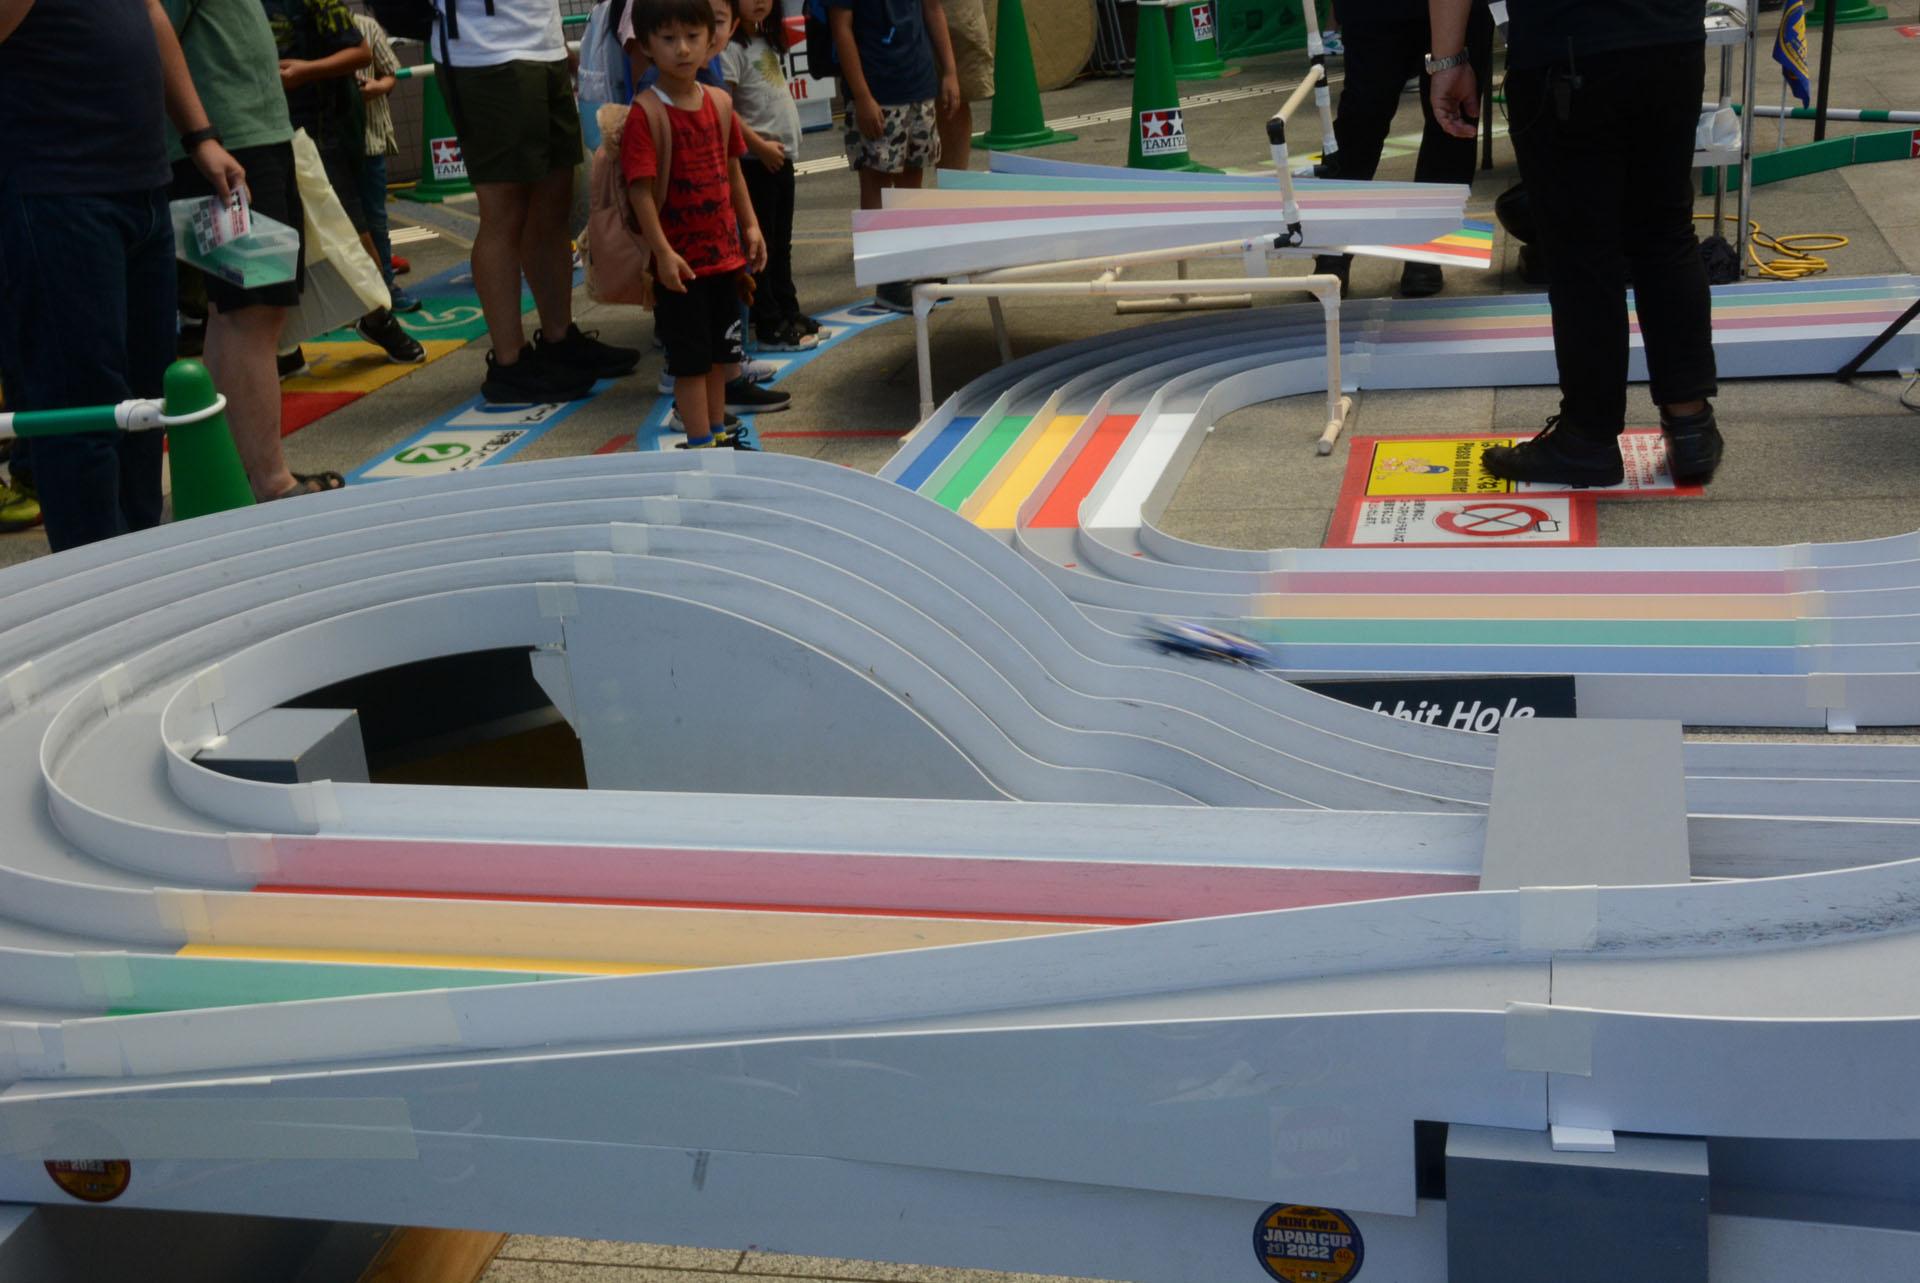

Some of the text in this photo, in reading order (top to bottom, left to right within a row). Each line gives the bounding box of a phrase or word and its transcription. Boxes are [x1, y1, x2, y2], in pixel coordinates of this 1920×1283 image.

[1452, 442, 1475, 492] Please do not enter
[1277, 1216, 1338, 1231] MINI 4WD
[1264, 1229, 1352, 1248] JAPAN CUP
[1286, 1243, 1330, 1259] 2022
